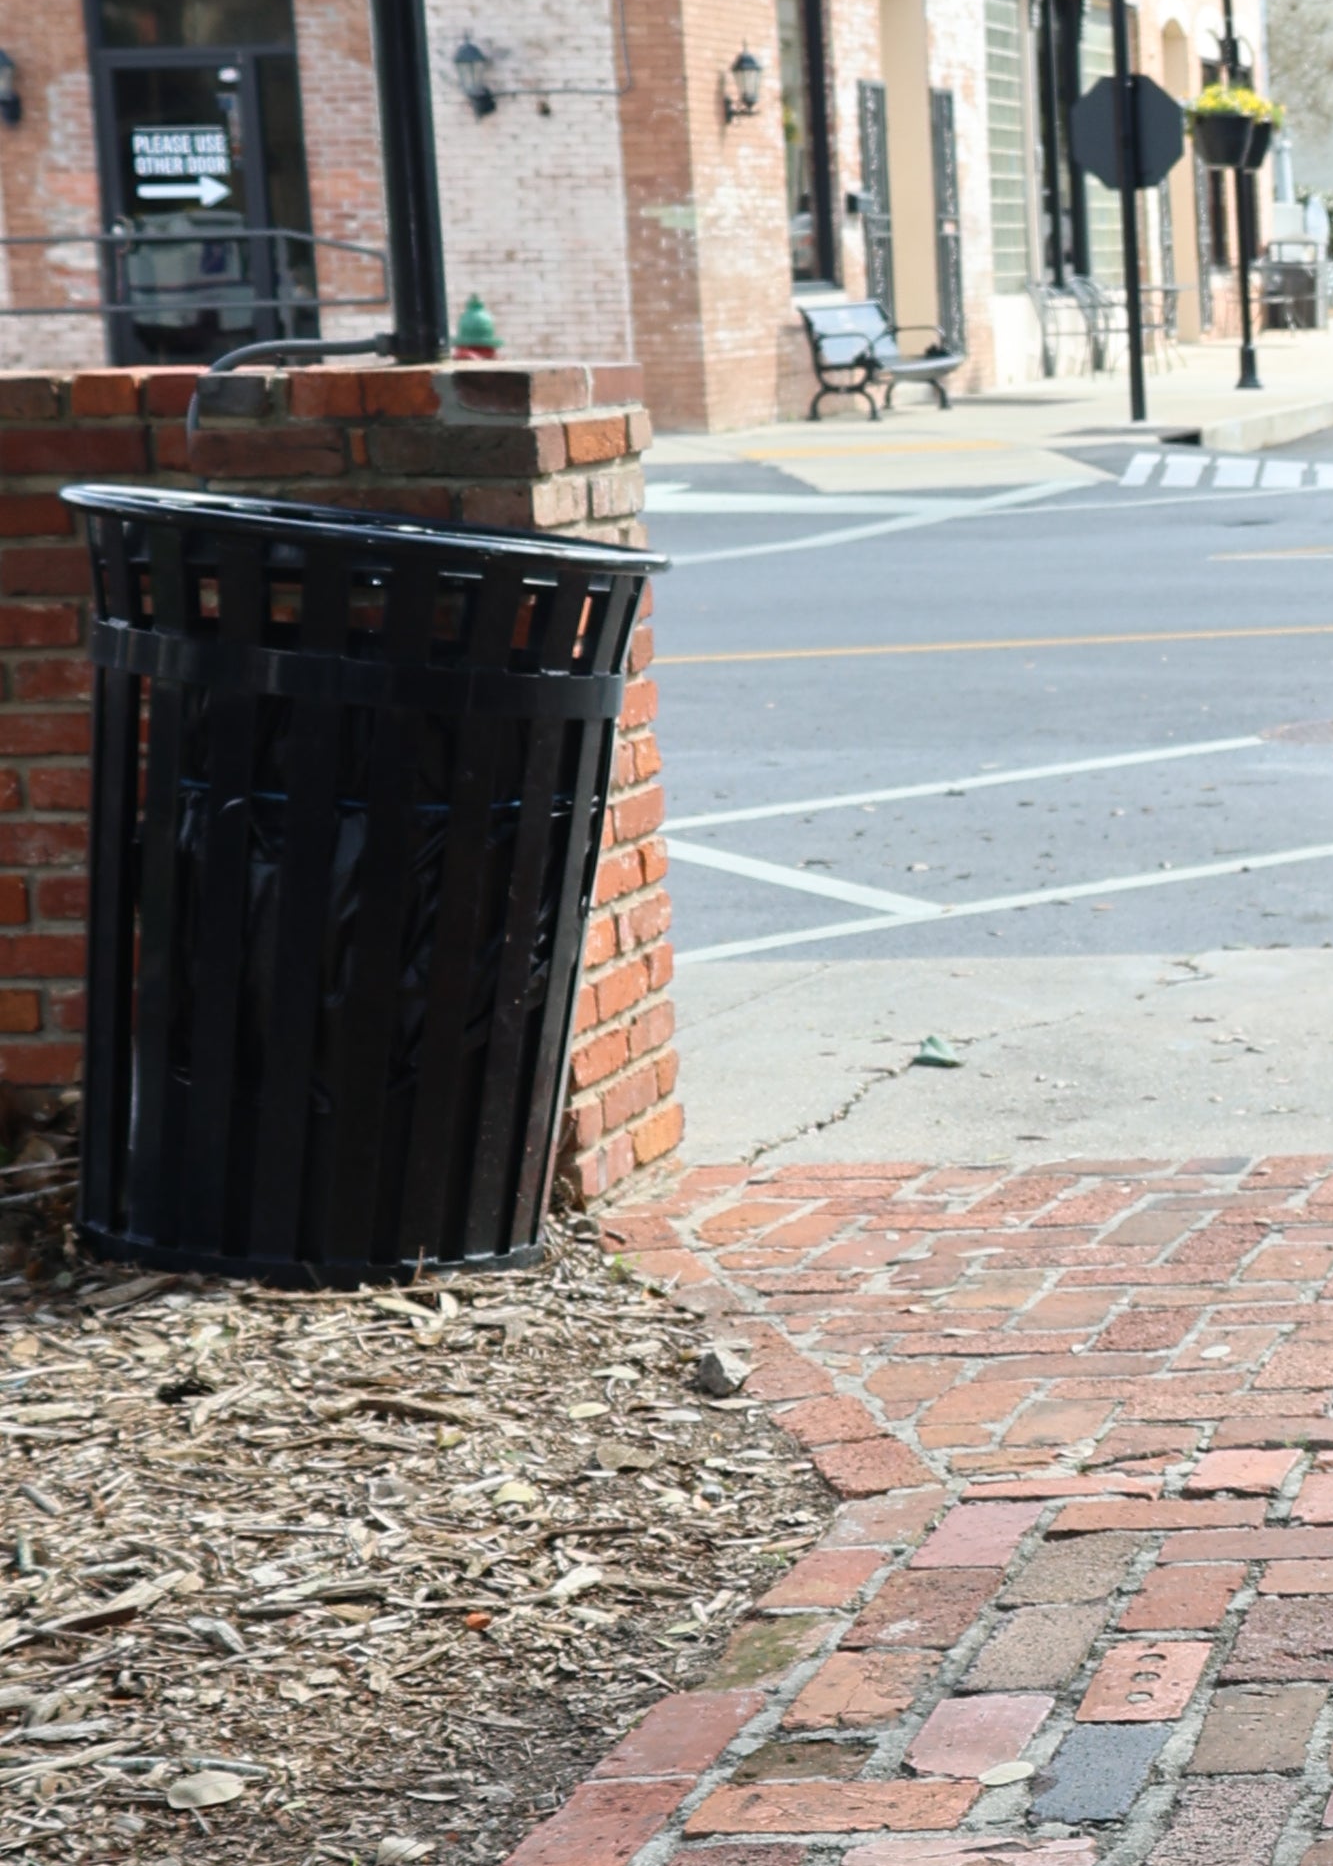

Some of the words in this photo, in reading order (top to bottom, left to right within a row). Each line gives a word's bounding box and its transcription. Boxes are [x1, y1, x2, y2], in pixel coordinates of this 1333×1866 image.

[133, 135, 192, 154] PLEASE
[194, 134, 226, 153] USE
[134, 156, 184, 175] OTHER
[187, 155, 228, 174] DOOR
